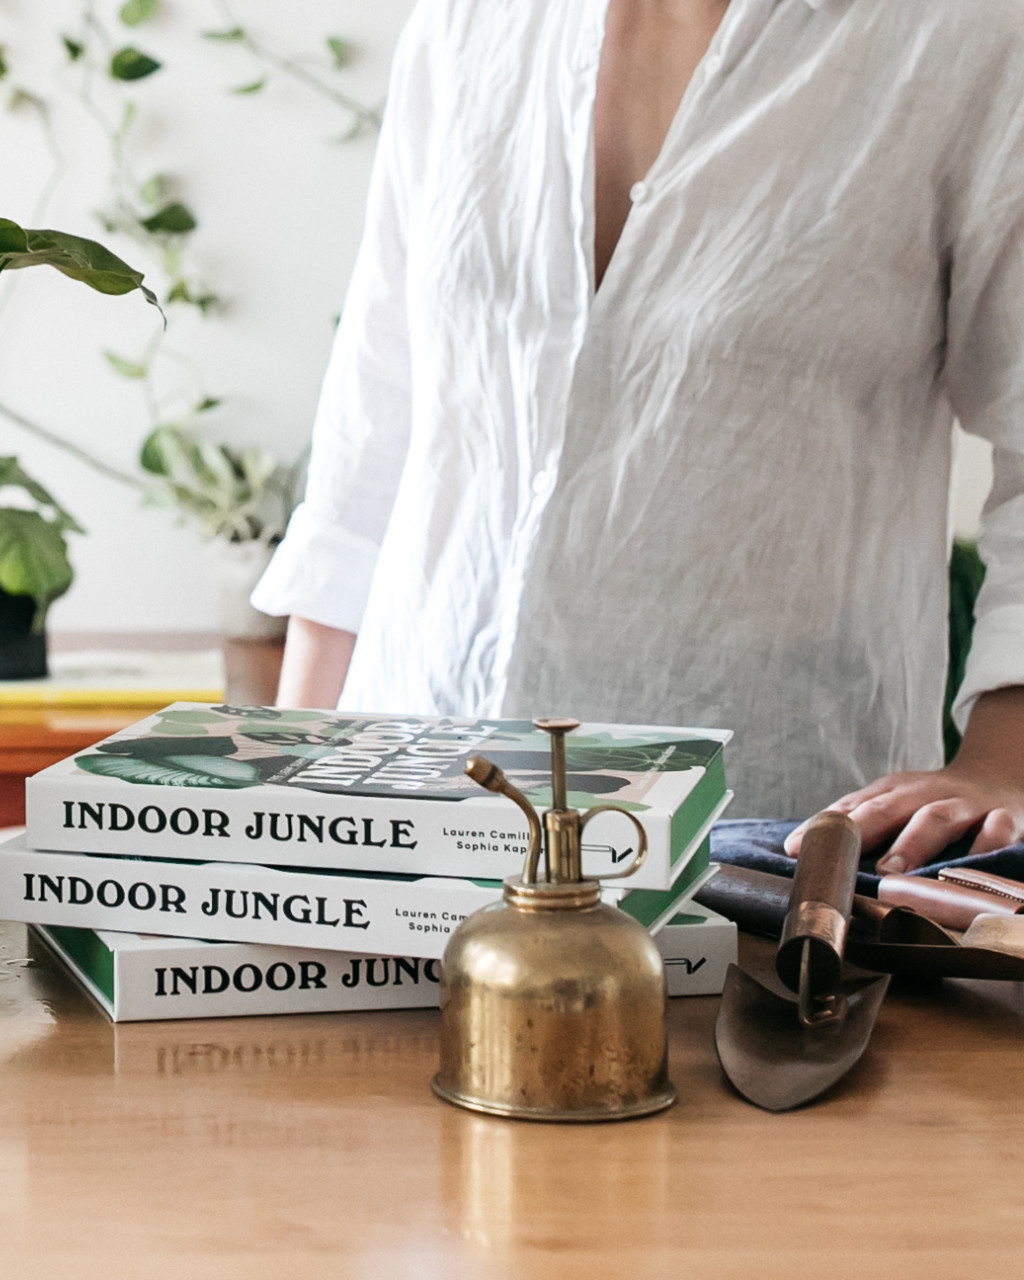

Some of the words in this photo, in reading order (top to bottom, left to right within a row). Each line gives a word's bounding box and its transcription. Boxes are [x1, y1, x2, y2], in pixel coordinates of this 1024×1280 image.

[287, 721, 431, 787] INDOOR
[361, 724, 499, 791] JUNGLE
[63, 801, 230, 838] INDOOR
[245, 812, 418, 850] JUNGLE
[443, 827, 485, 838] Lauren
[456, 841, 499, 852] Sophia
[23, 873, 187, 913] INDOOR
[201, 888, 370, 930] JUNGLE
[395, 908, 436, 919] Lauren
[408, 922, 451, 933] Sophia
[155, 961, 327, 996] INDOOR
